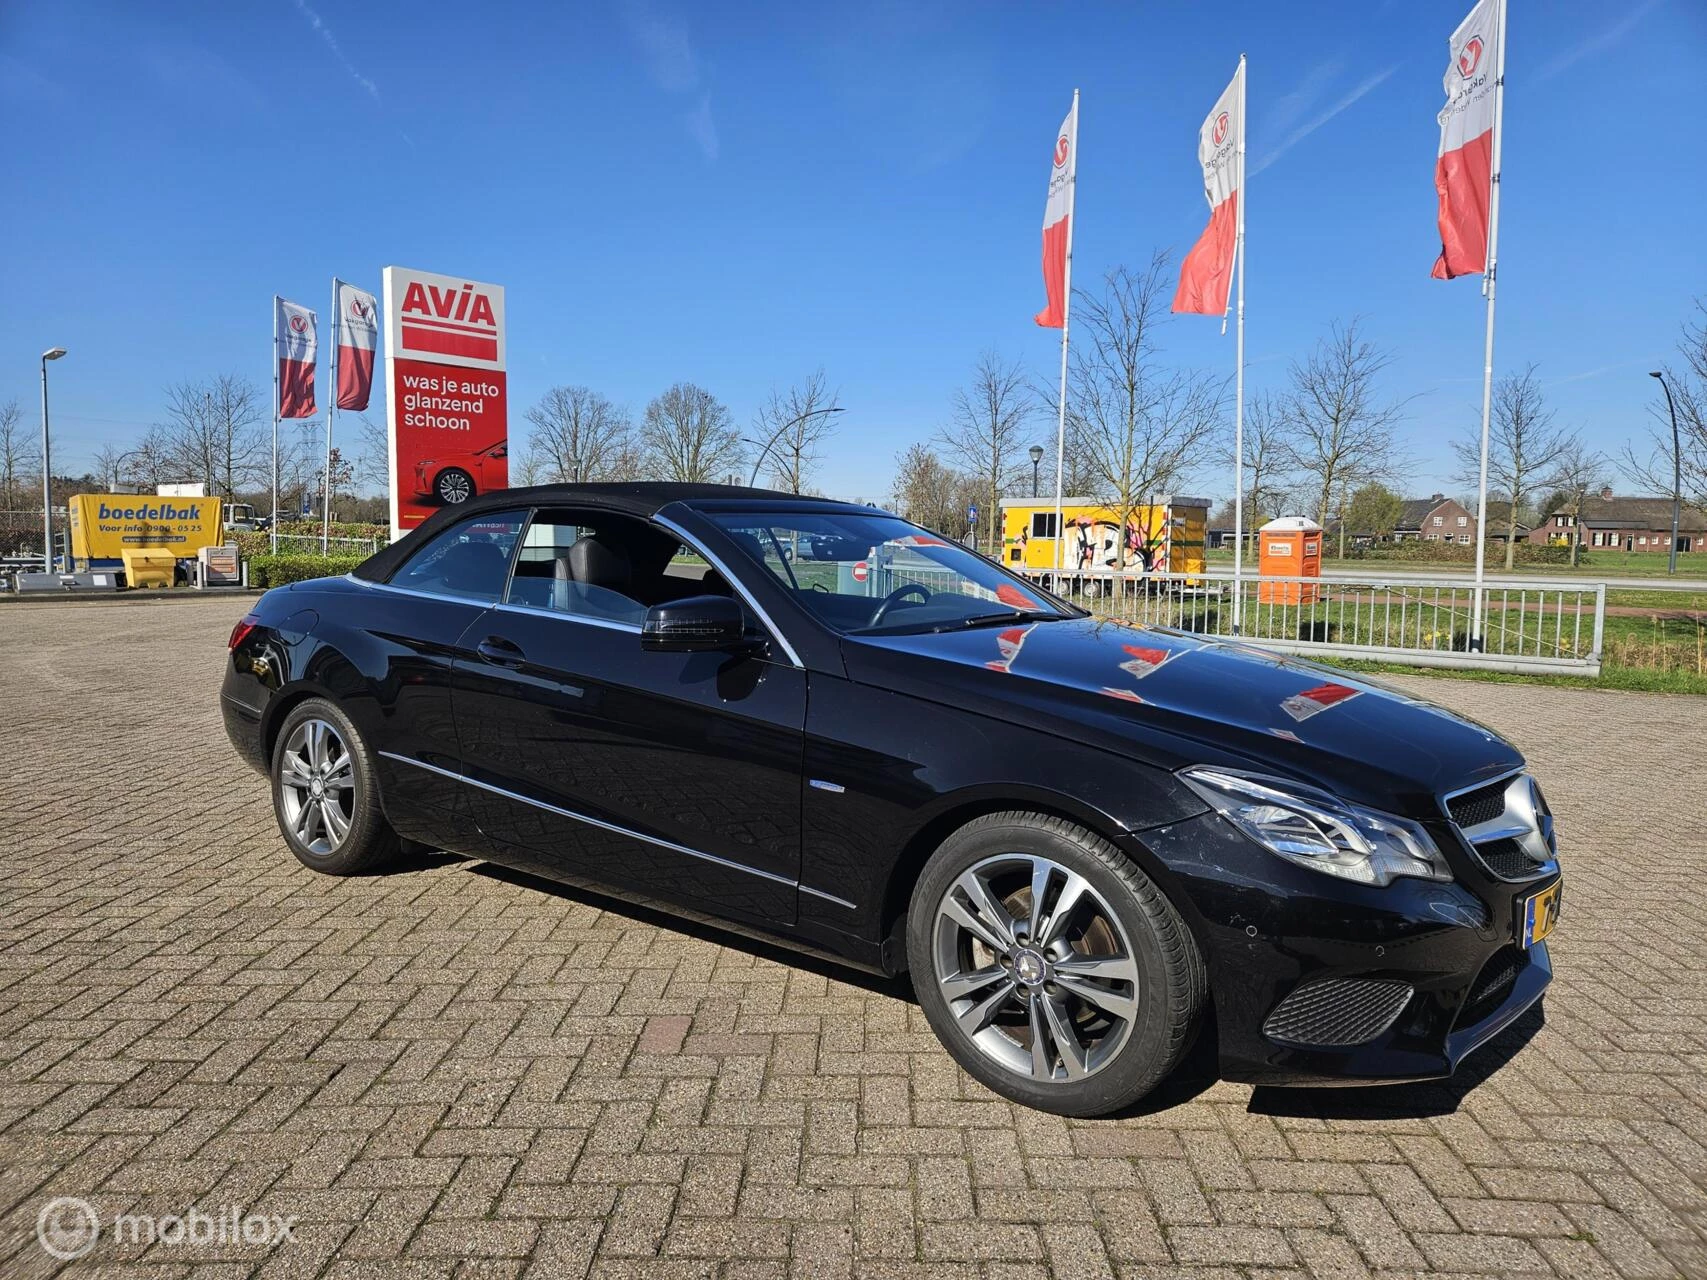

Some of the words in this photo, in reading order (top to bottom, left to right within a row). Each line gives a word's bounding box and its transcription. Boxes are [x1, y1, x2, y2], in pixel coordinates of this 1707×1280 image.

[403, 375, 439, 390] was
[441, 376, 458, 395] je
[461, 382, 499, 397] auto
[404, 392, 483, 414] glanzend
[404, 412, 470, 430] schoon
[98, 503, 200, 520] boedelbak
[98, 524, 121, 532] Voor
[124, 524, 143, 532] info
